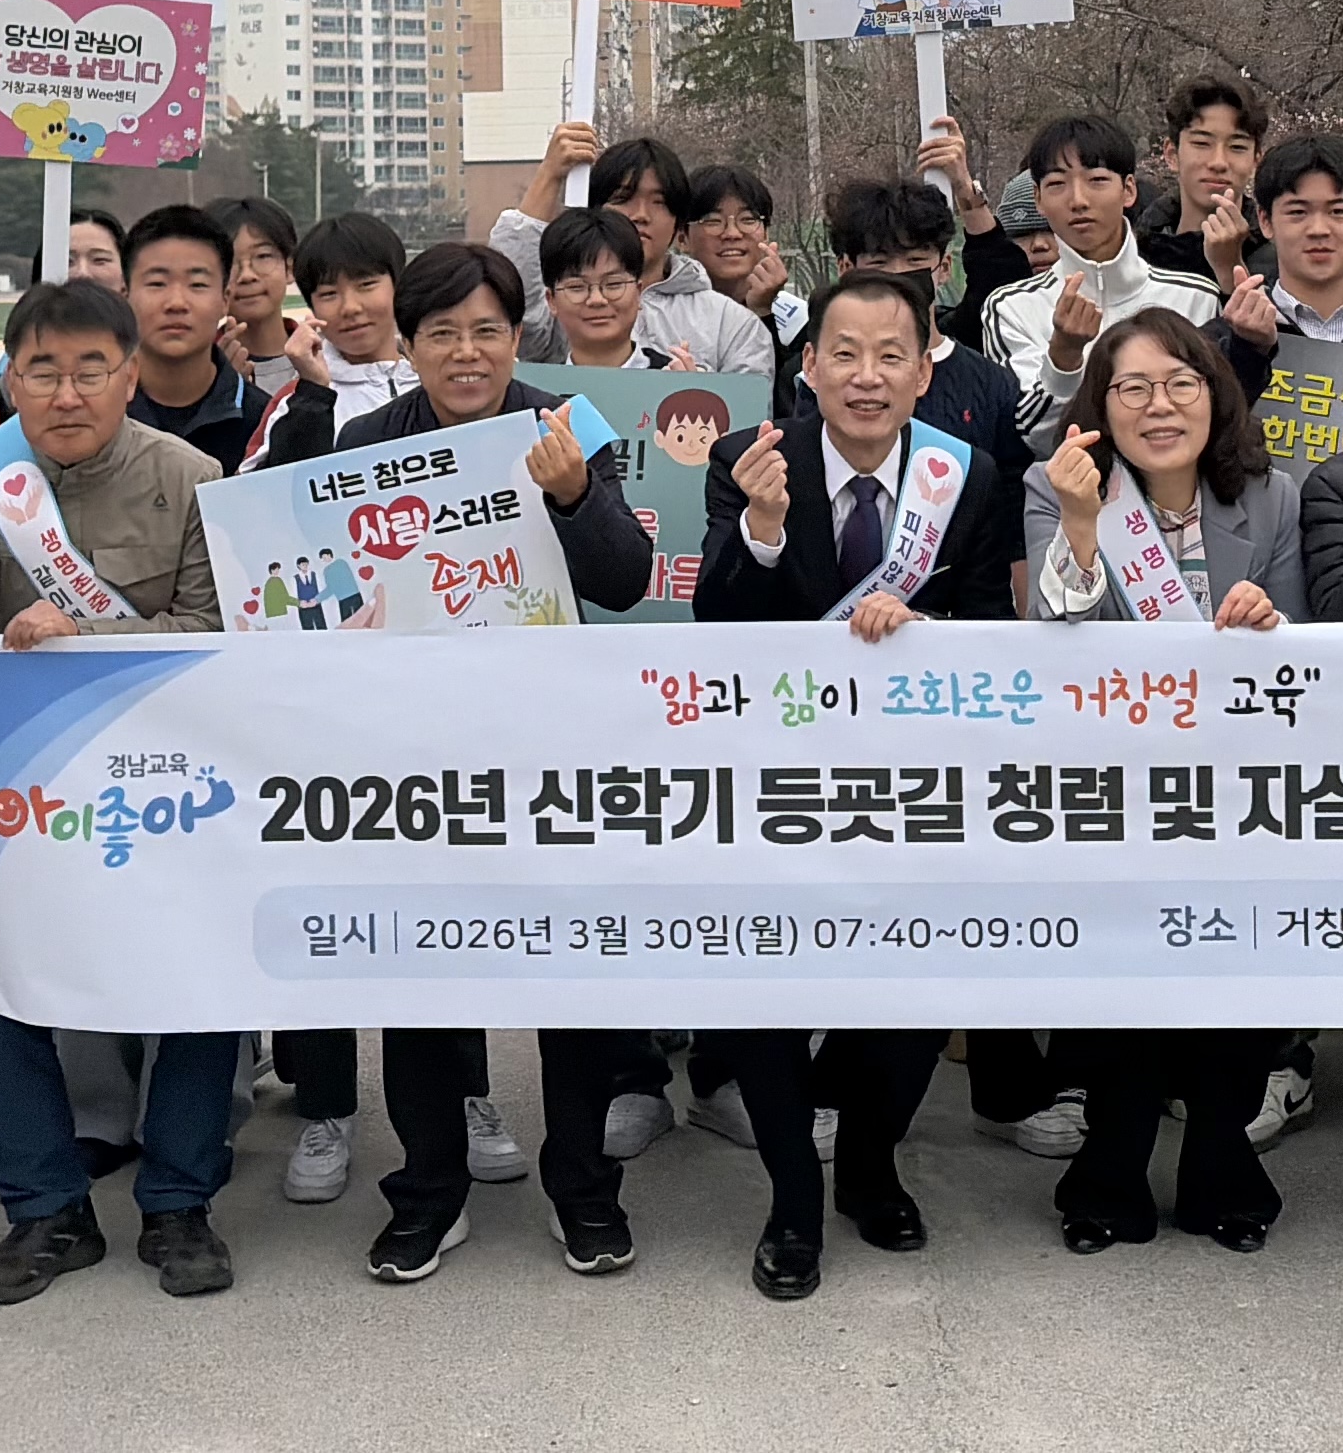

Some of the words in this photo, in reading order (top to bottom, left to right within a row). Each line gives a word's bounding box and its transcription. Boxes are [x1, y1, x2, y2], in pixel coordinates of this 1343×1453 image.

[862, 8, 947, 28] 거창교육지원청
[950, 5, 1002, 21] Wee센터
[5, 24, 69, 51] 당신의
[74, 29, 143, 57] 관심이
[6, 51, 72, 78] 생명을
[77, 56, 163, 85] 살립니다
[1, 79, 83, 99] 거창교육지원청
[87, 87, 137, 104] Wee센터
[309, 470, 366, 505] 너는
[372, 448, 458, 492] 참으로
[357, 489, 521, 548] 사랑스러운
[40, 527, 112, 614] 생명존중
[1125, 509, 1185, 606] 생명은
[423, 547, 522, 615] 존재
[641, 668, 751, 726] "앎과
[771, 669, 859, 727] 삶이
[882, 668, 1043, 726] 조화로운
[1062, 668, 1199, 729] 거창얼
[1223, 663, 1321, 728] 교육"
[106, 753, 190, 779] 경남교육
[259, 768, 507, 847] 2026년
[529, 765, 735, 846] 신학기
[756, 765, 966, 845] 등굣길
[987, 762, 1126, 844] 청렴
[1148, 765, 1216, 842] 및
[301, 911, 377, 957] 일시
[414, 914, 553, 956] 2026년
[568, 914, 629, 956] 3월
[643, 913, 797, 957] 30일(월)
[813, 917, 1080, 950] 07:40~09:00
[1159, 907, 1236, 948] 장소
